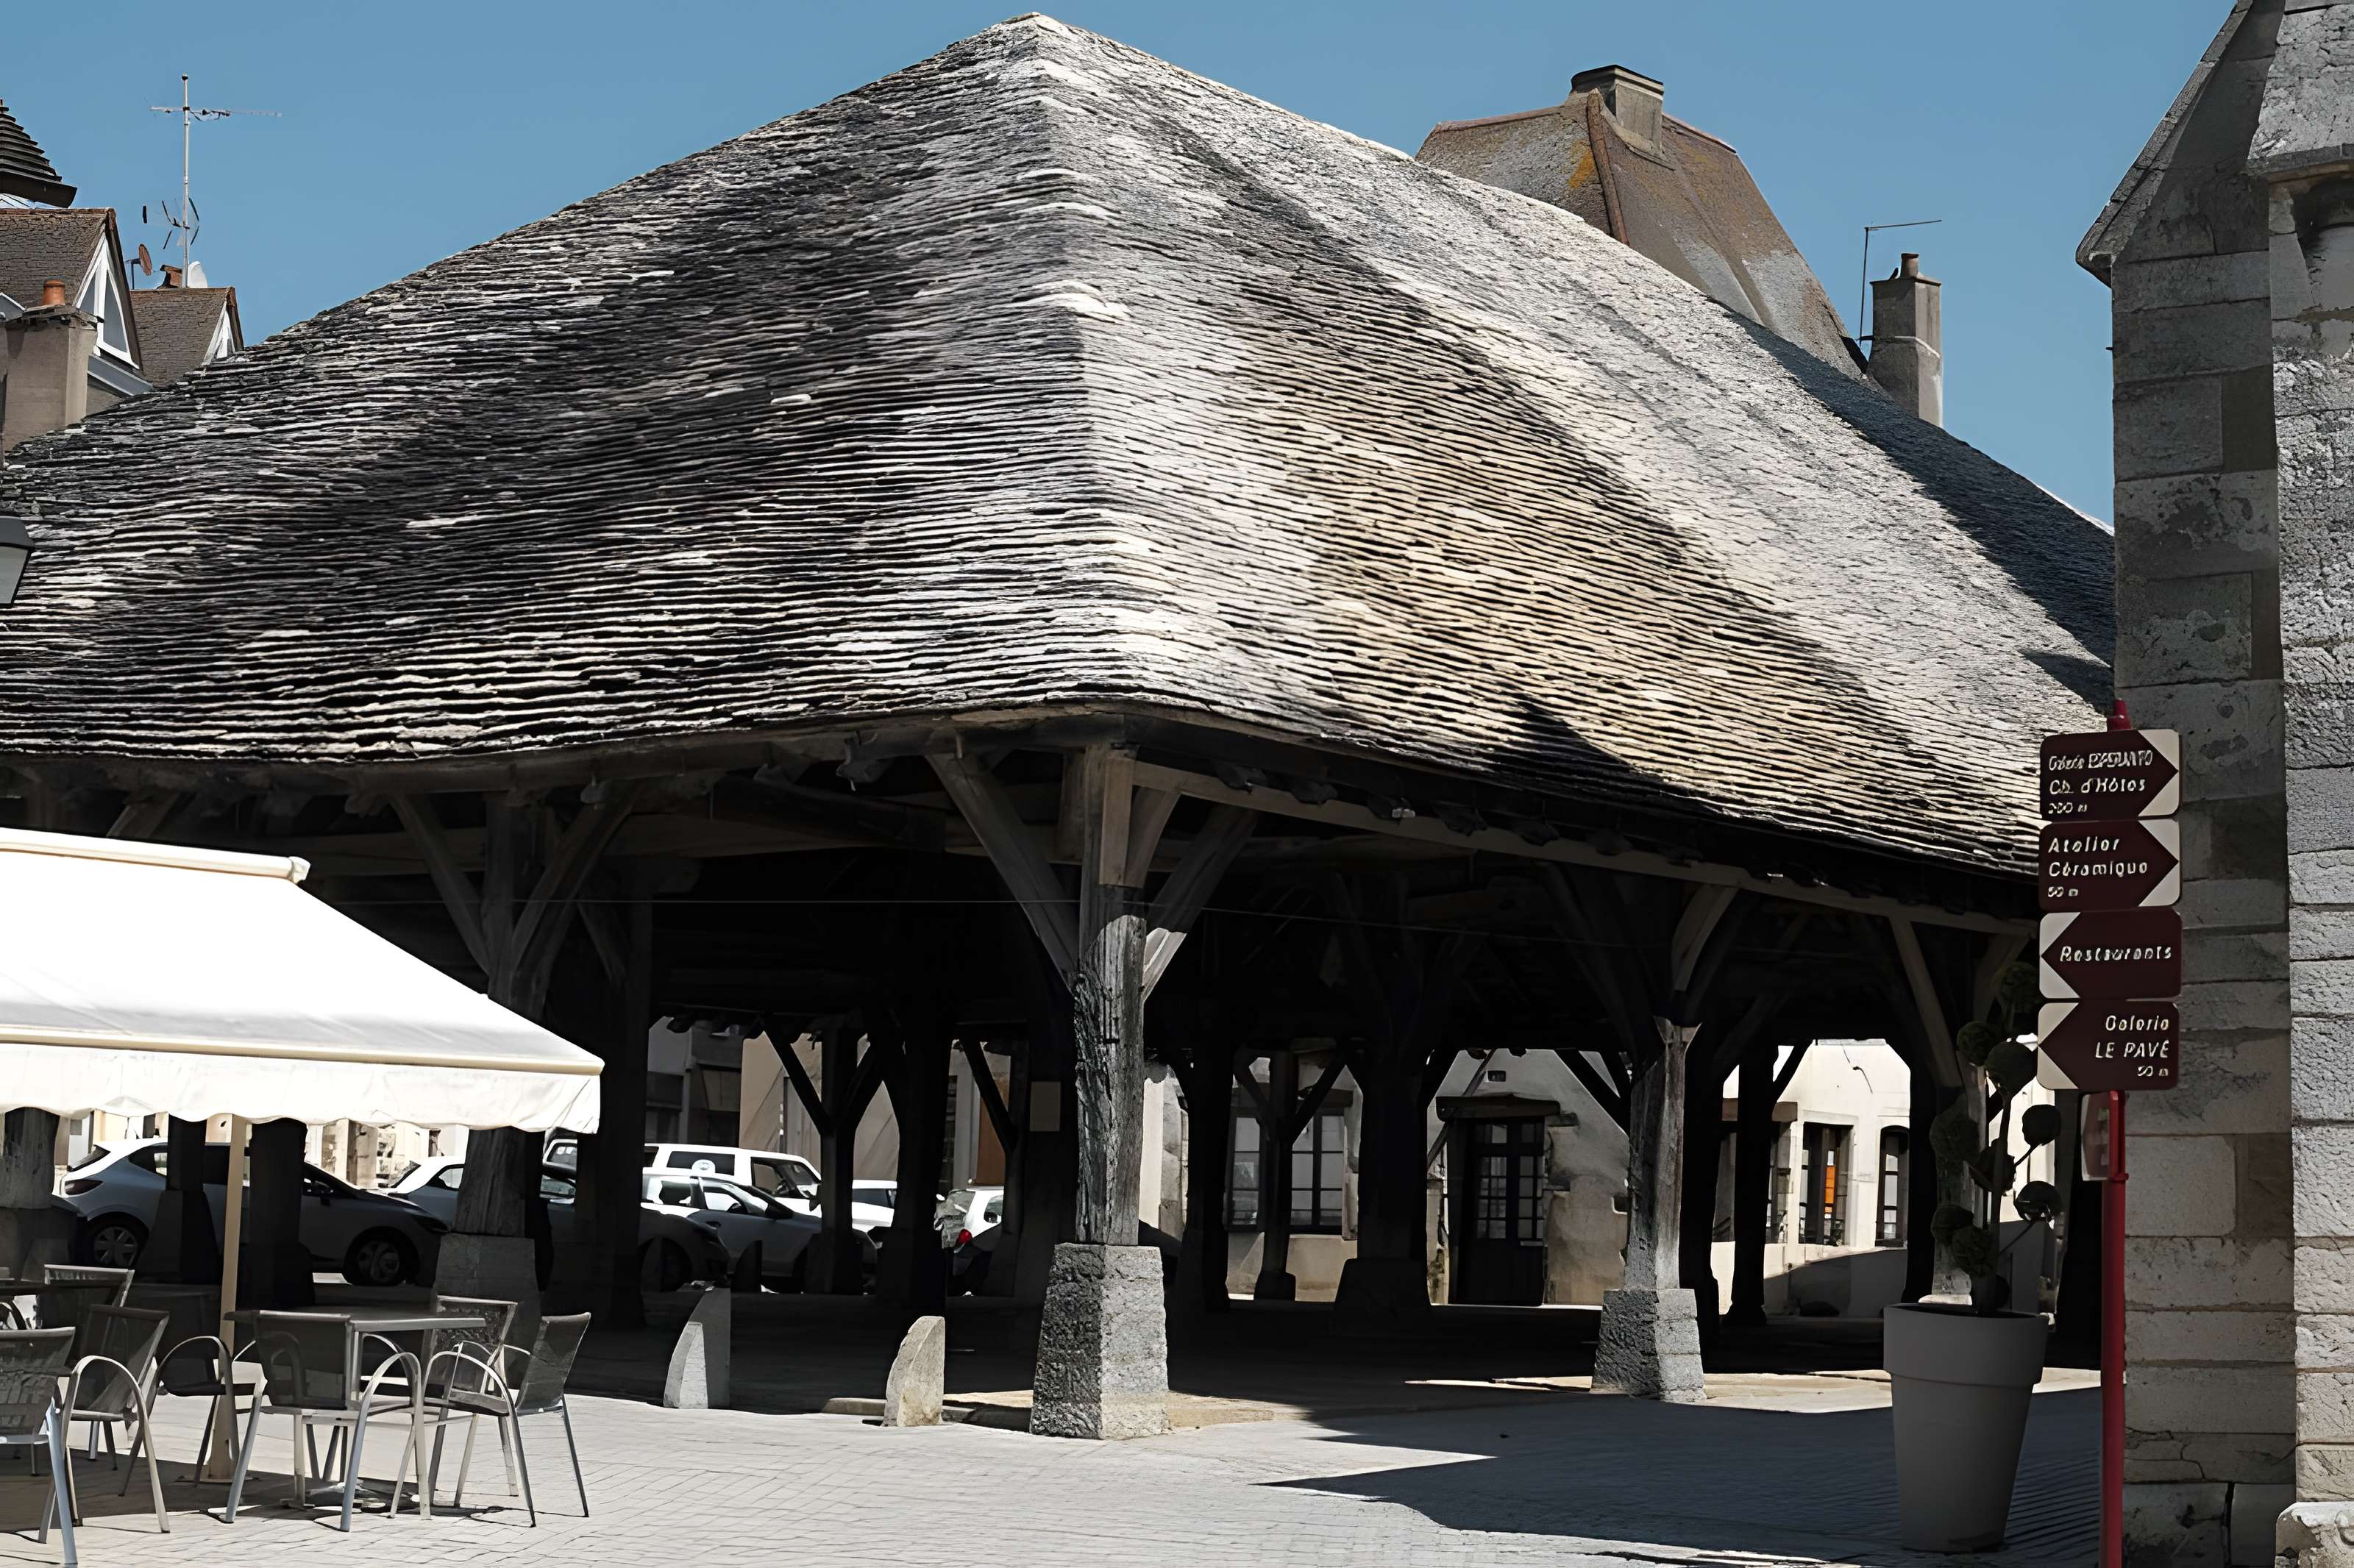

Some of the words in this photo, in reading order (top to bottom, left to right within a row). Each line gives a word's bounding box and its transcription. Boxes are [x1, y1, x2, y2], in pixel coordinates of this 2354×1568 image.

[2048, 836, 2120, 853] Atelier
[2060, 946, 2172, 962] Restaurants
[2105, 1015, 2169, 1031] Galerie
[2095, 1041, 2115, 1058] LE
[2123, 1039, 2170, 1058] PAVÉ
